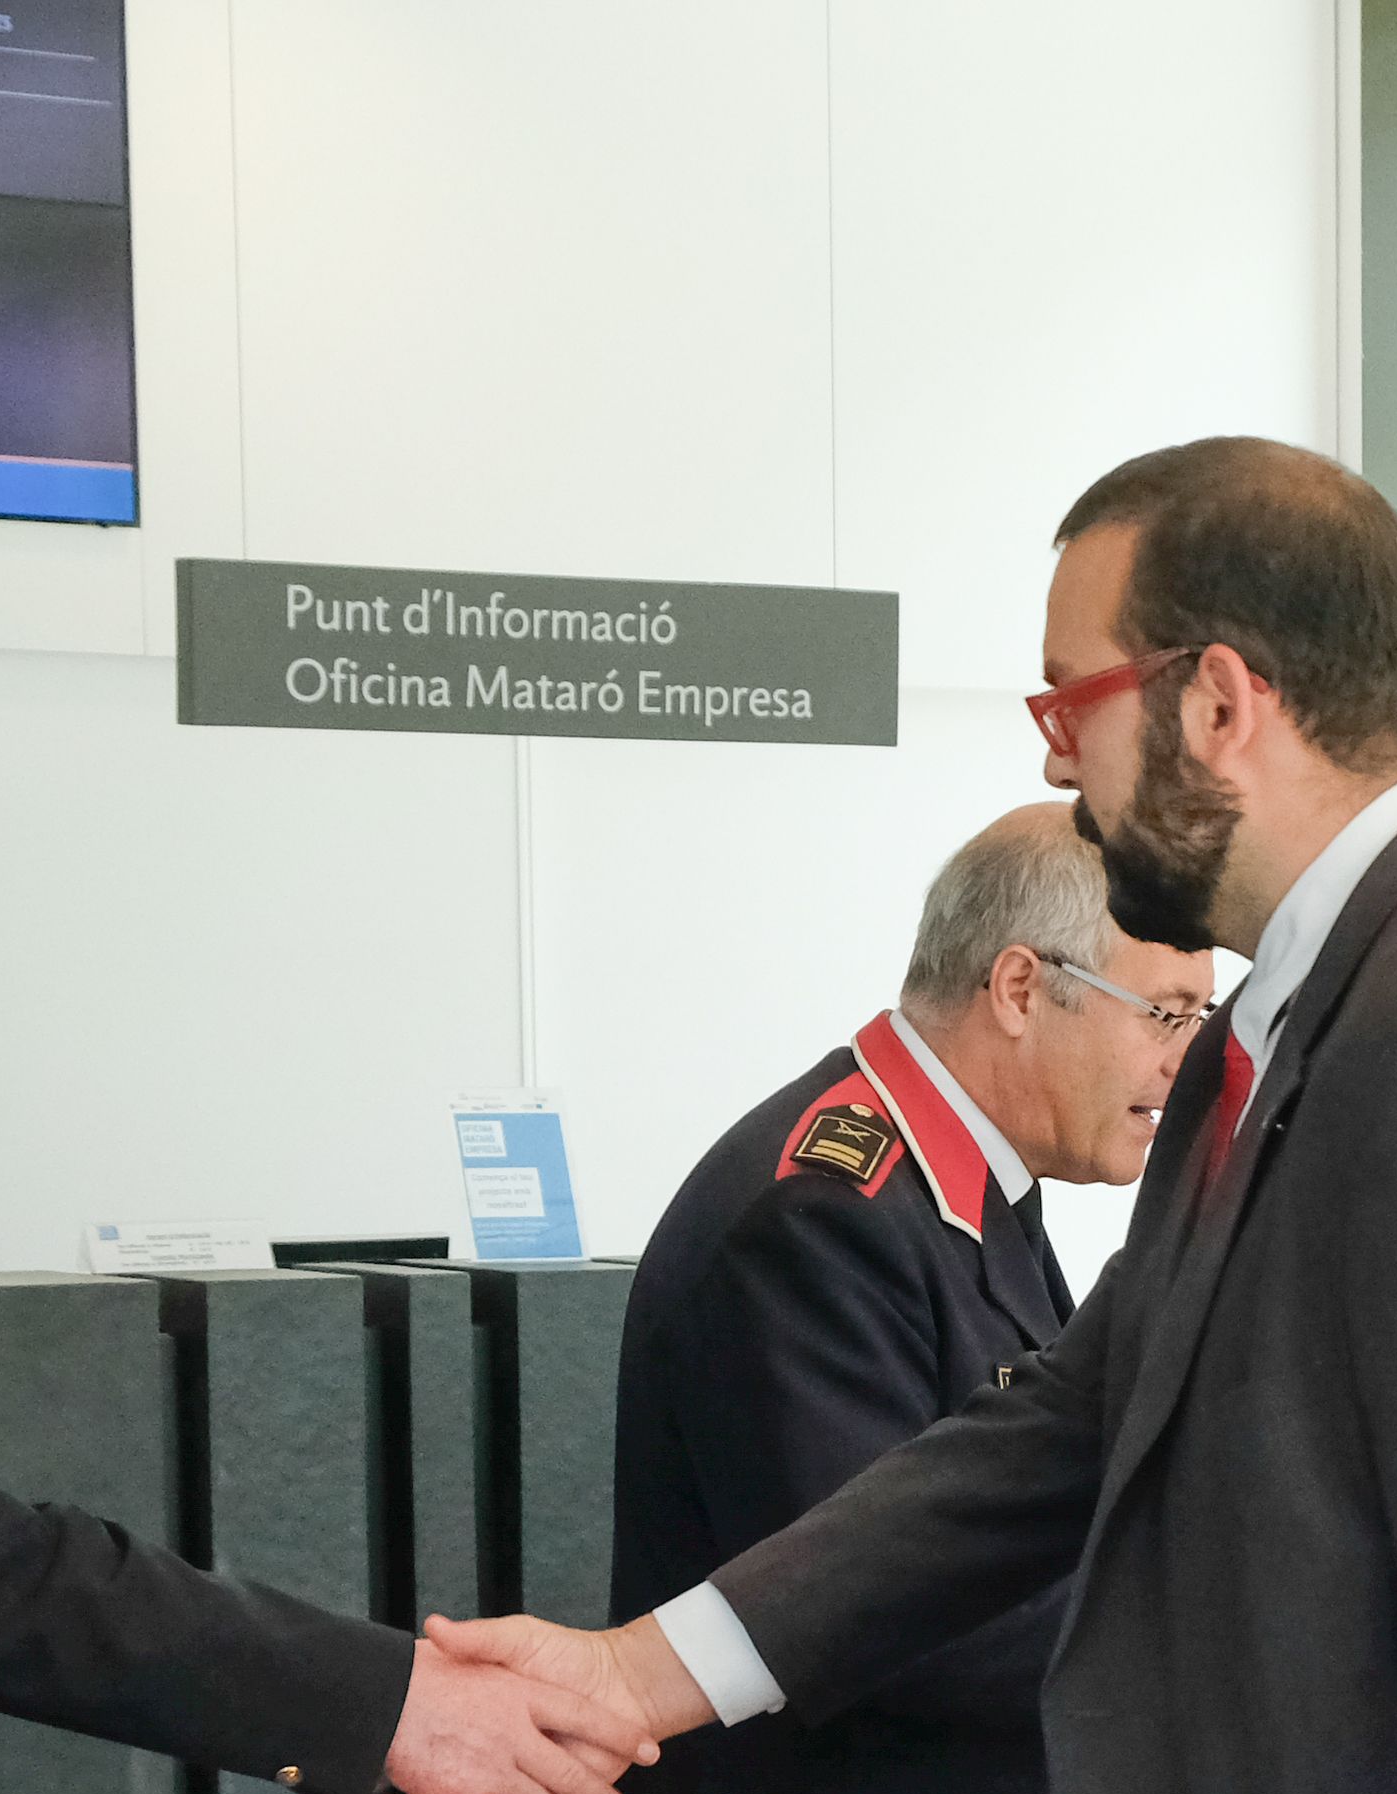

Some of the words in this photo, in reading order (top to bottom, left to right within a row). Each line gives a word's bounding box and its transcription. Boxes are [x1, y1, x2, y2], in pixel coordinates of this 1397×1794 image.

[287, 584, 391, 632] Punt
[403, 589, 676, 644] d'Informació
[286, 658, 451, 707] Oficina
[467, 665, 624, 712] Mataró
[639, 671, 813, 726] Empresa
